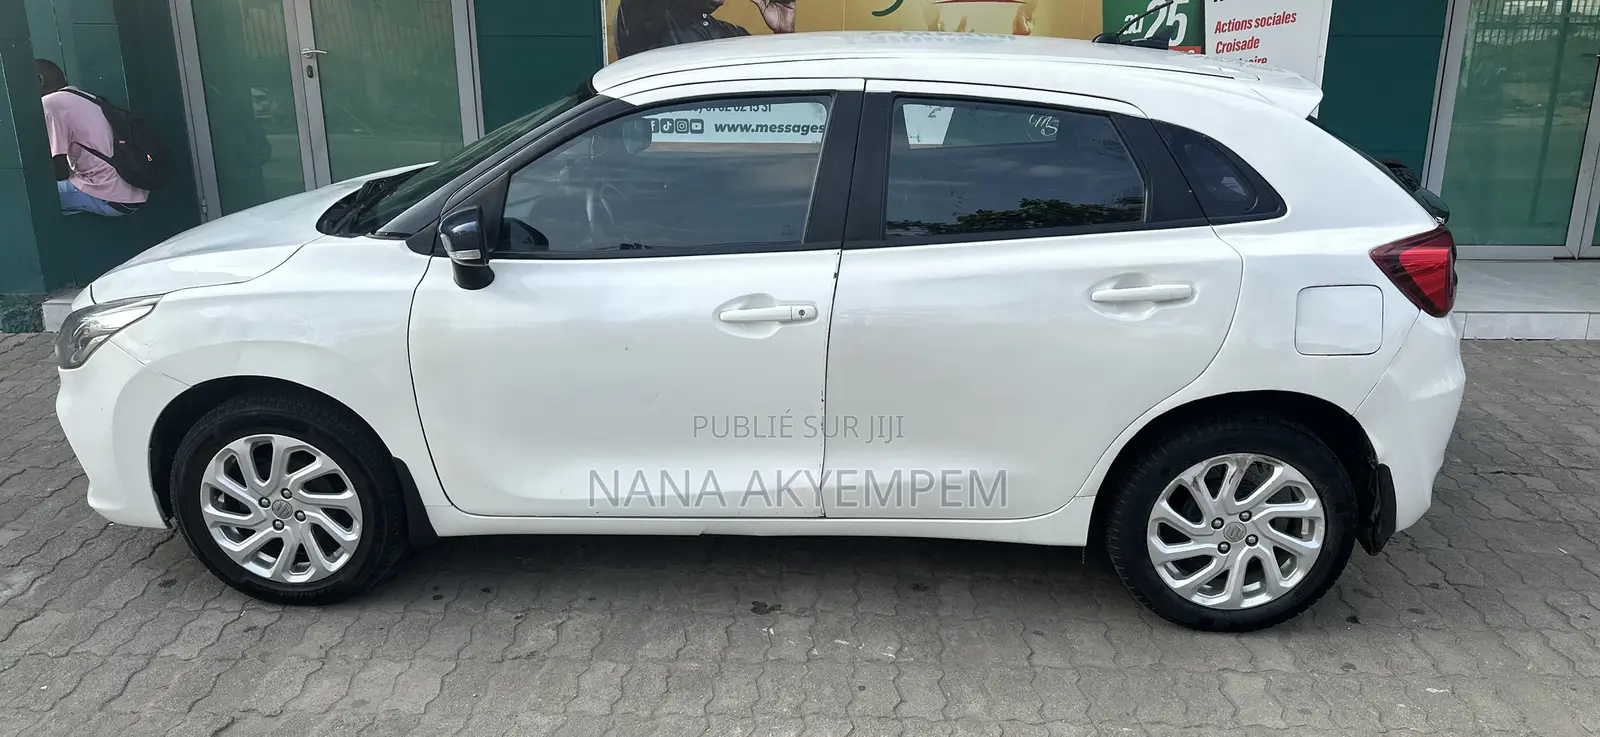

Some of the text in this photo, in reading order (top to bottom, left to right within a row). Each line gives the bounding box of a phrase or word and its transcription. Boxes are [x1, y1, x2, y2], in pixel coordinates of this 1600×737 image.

[1144, 0, 1190, 47] 25
[1214, 11, 1297, 34] Actions sociales
[1215, 36, 1260, 54] Croisade
